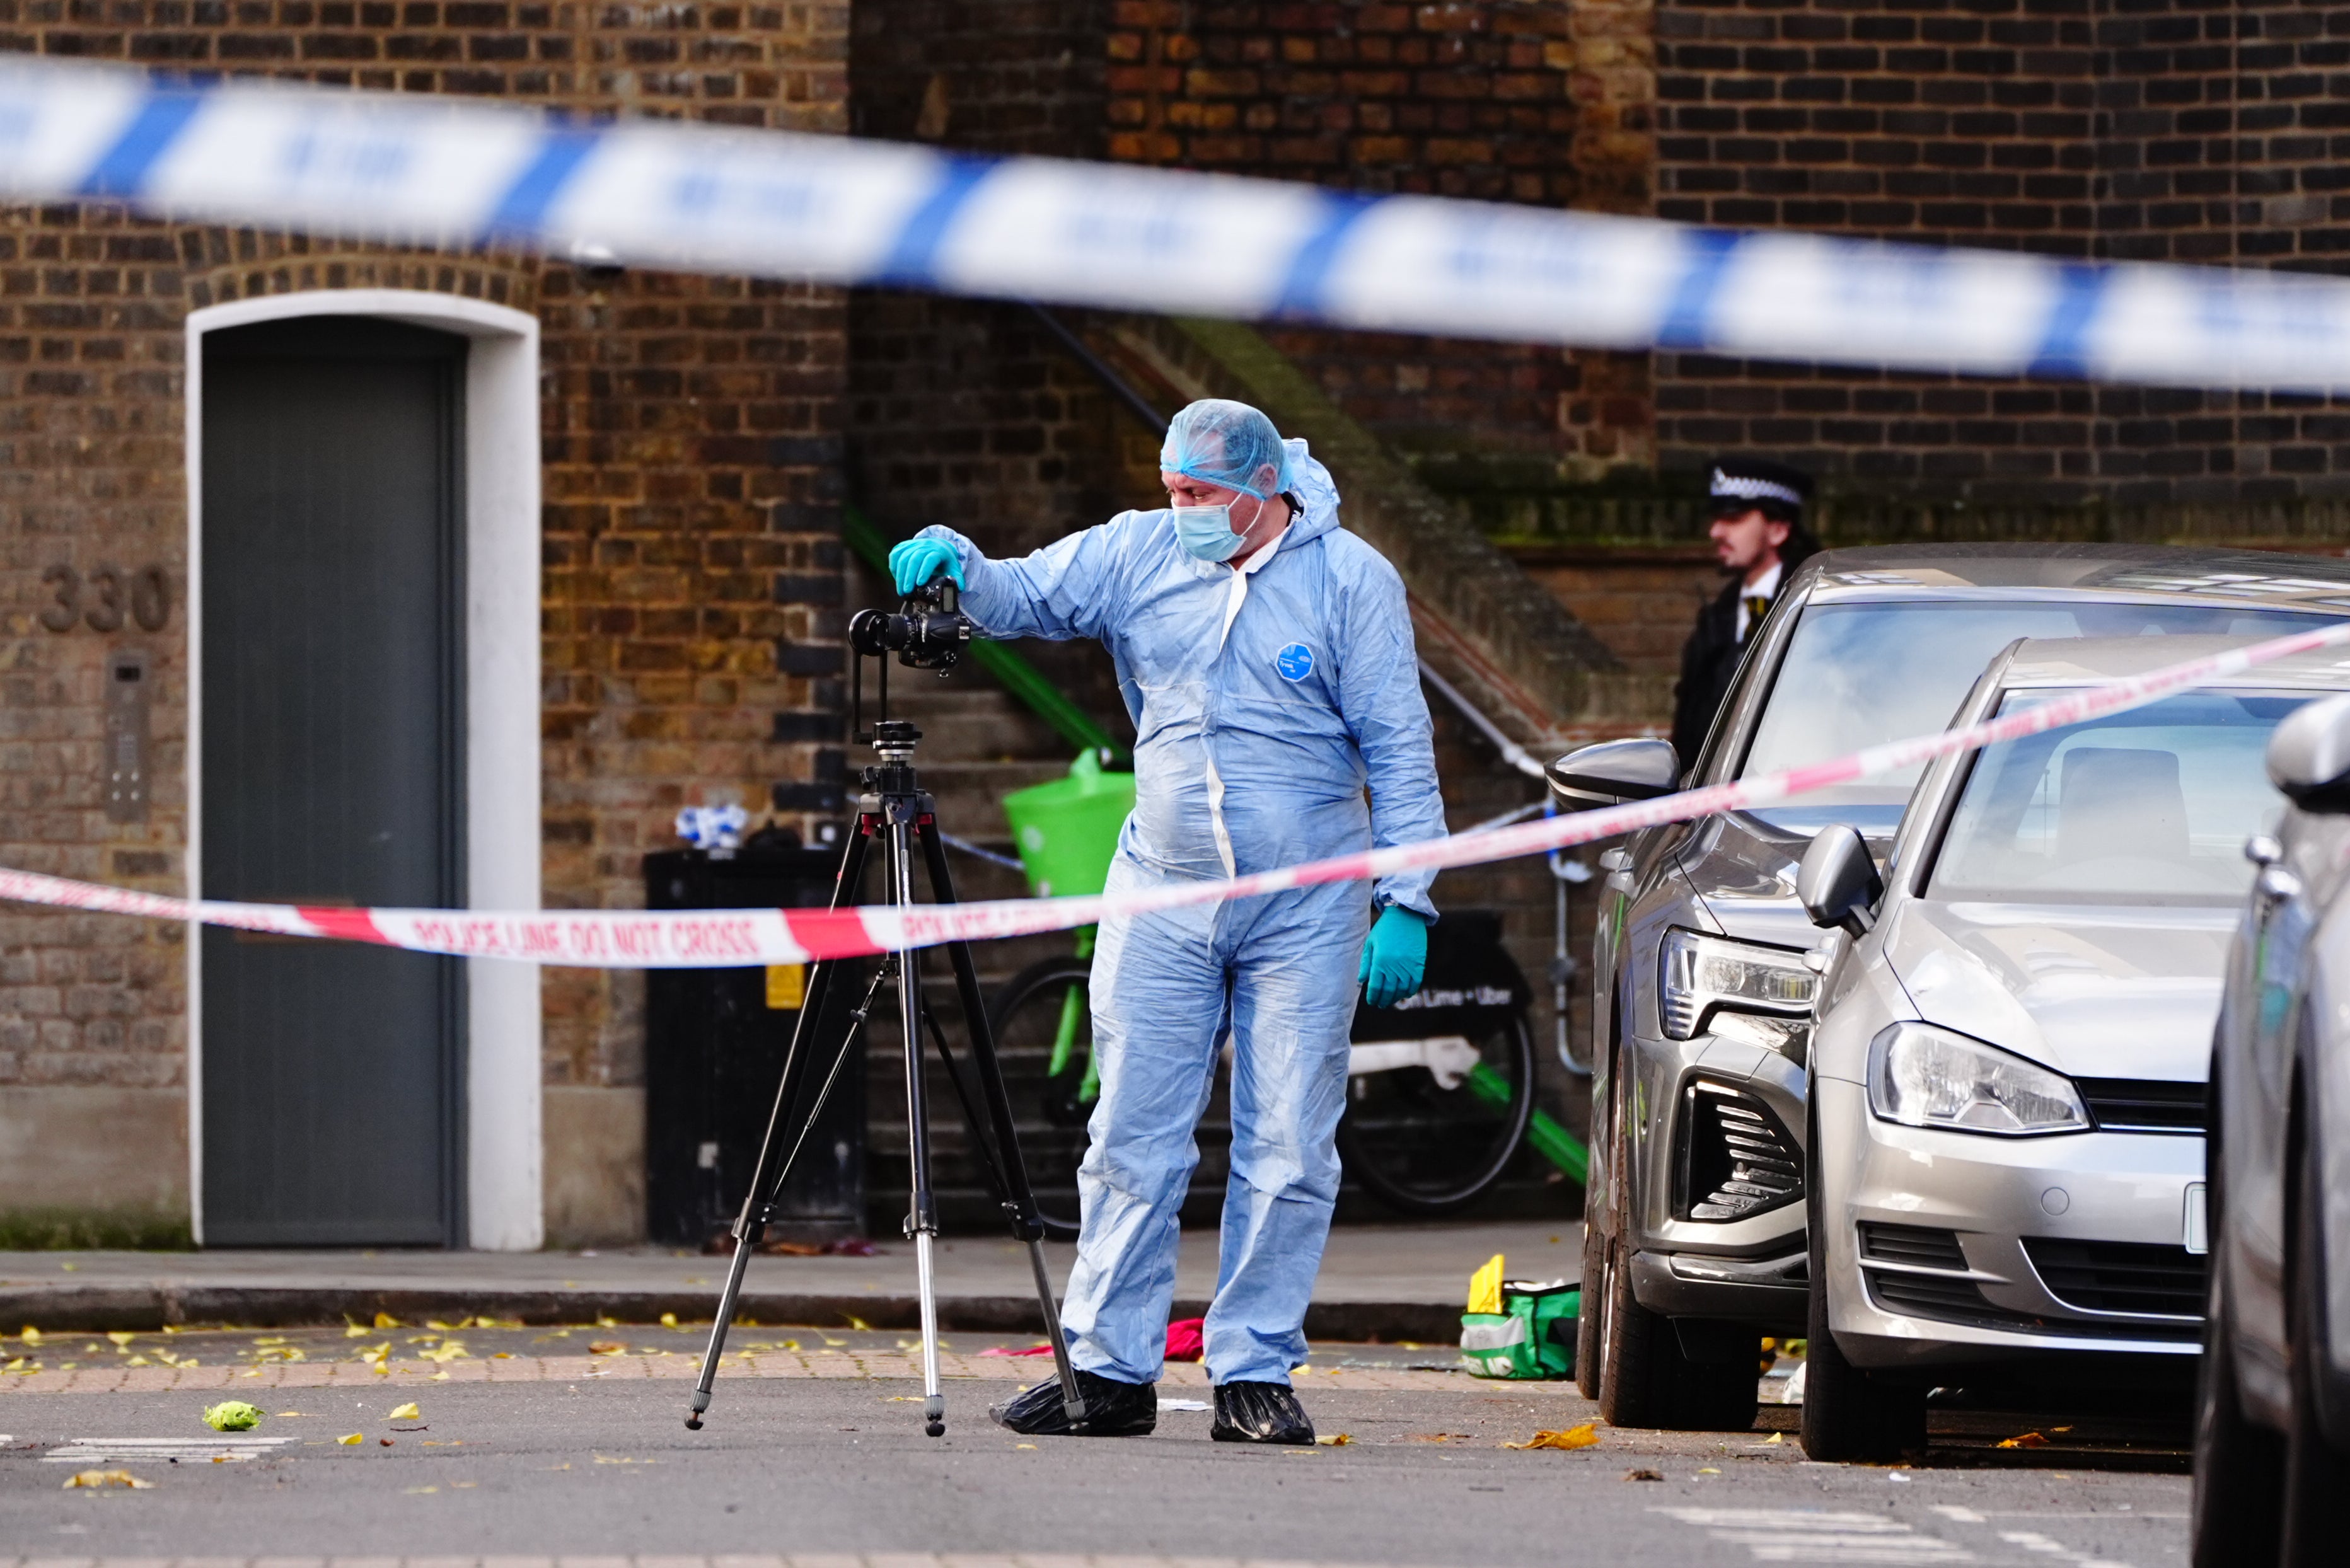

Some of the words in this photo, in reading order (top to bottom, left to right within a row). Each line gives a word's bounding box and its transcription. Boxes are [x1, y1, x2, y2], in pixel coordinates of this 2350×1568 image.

[38, 563, 173, 632] 330
[413, 919, 506, 954] POLICE
[504, 919, 569, 956] LINE
[569, 919, 608, 957] DO
[611, 919, 662, 957] NOT
[670, 919, 761, 957] CROSS
[1475, 984, 1511, 1005] Uber
